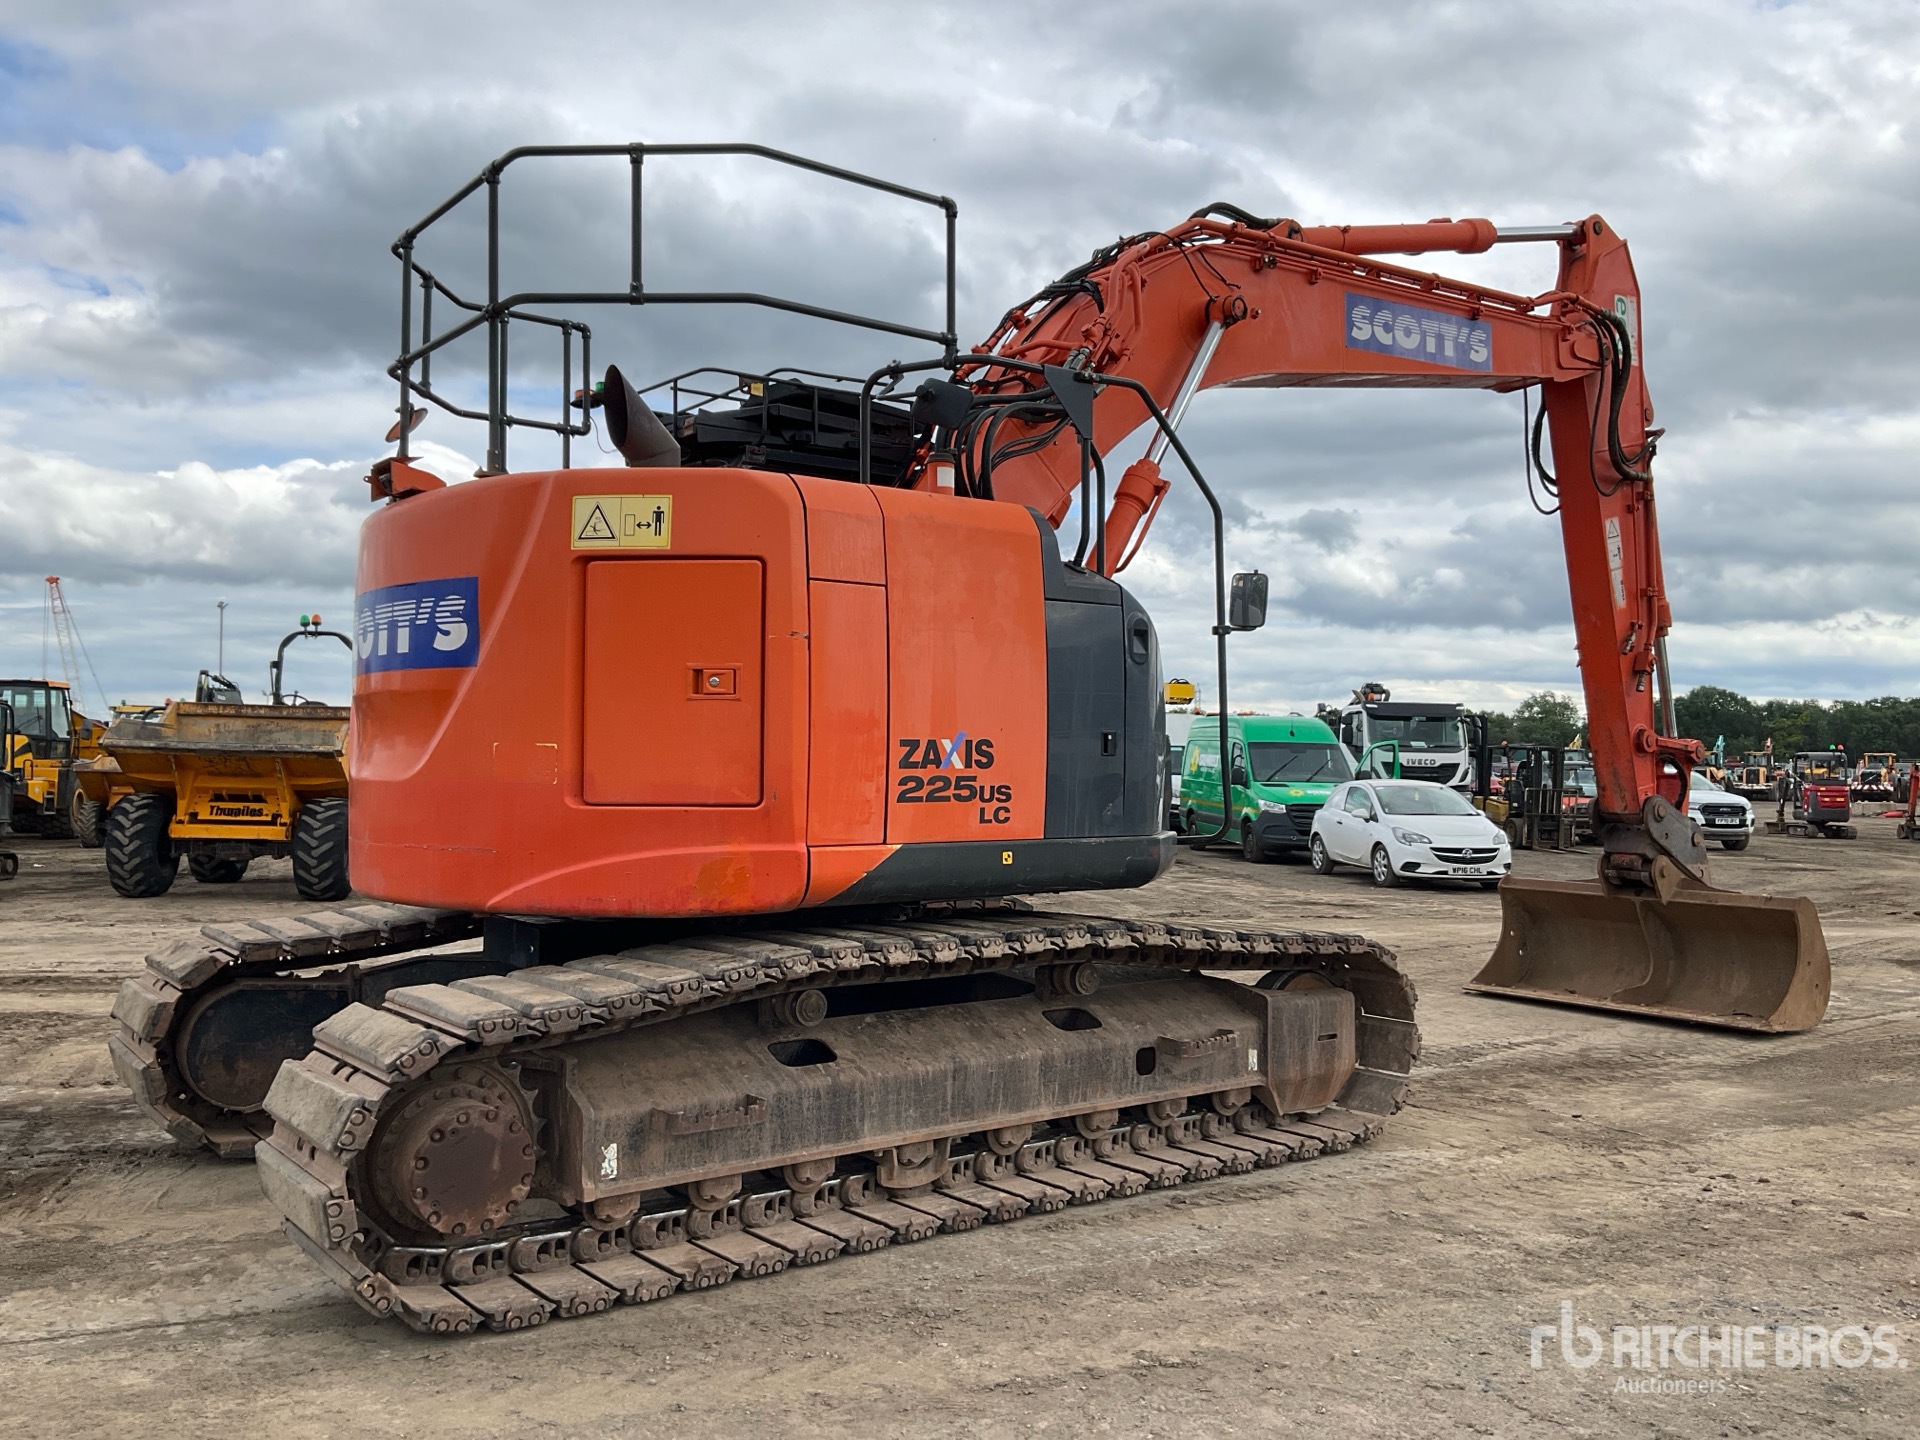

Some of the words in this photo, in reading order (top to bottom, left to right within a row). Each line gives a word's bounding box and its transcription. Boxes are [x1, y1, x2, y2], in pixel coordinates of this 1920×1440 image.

[1351, 305, 1488, 363] SCOTT'S
[356, 594, 469, 660] OTT'S
[899, 731, 995, 769] ZAXIS
[1406, 758, 1437, 766] IVECO
[979, 806, 1011, 824] LC
